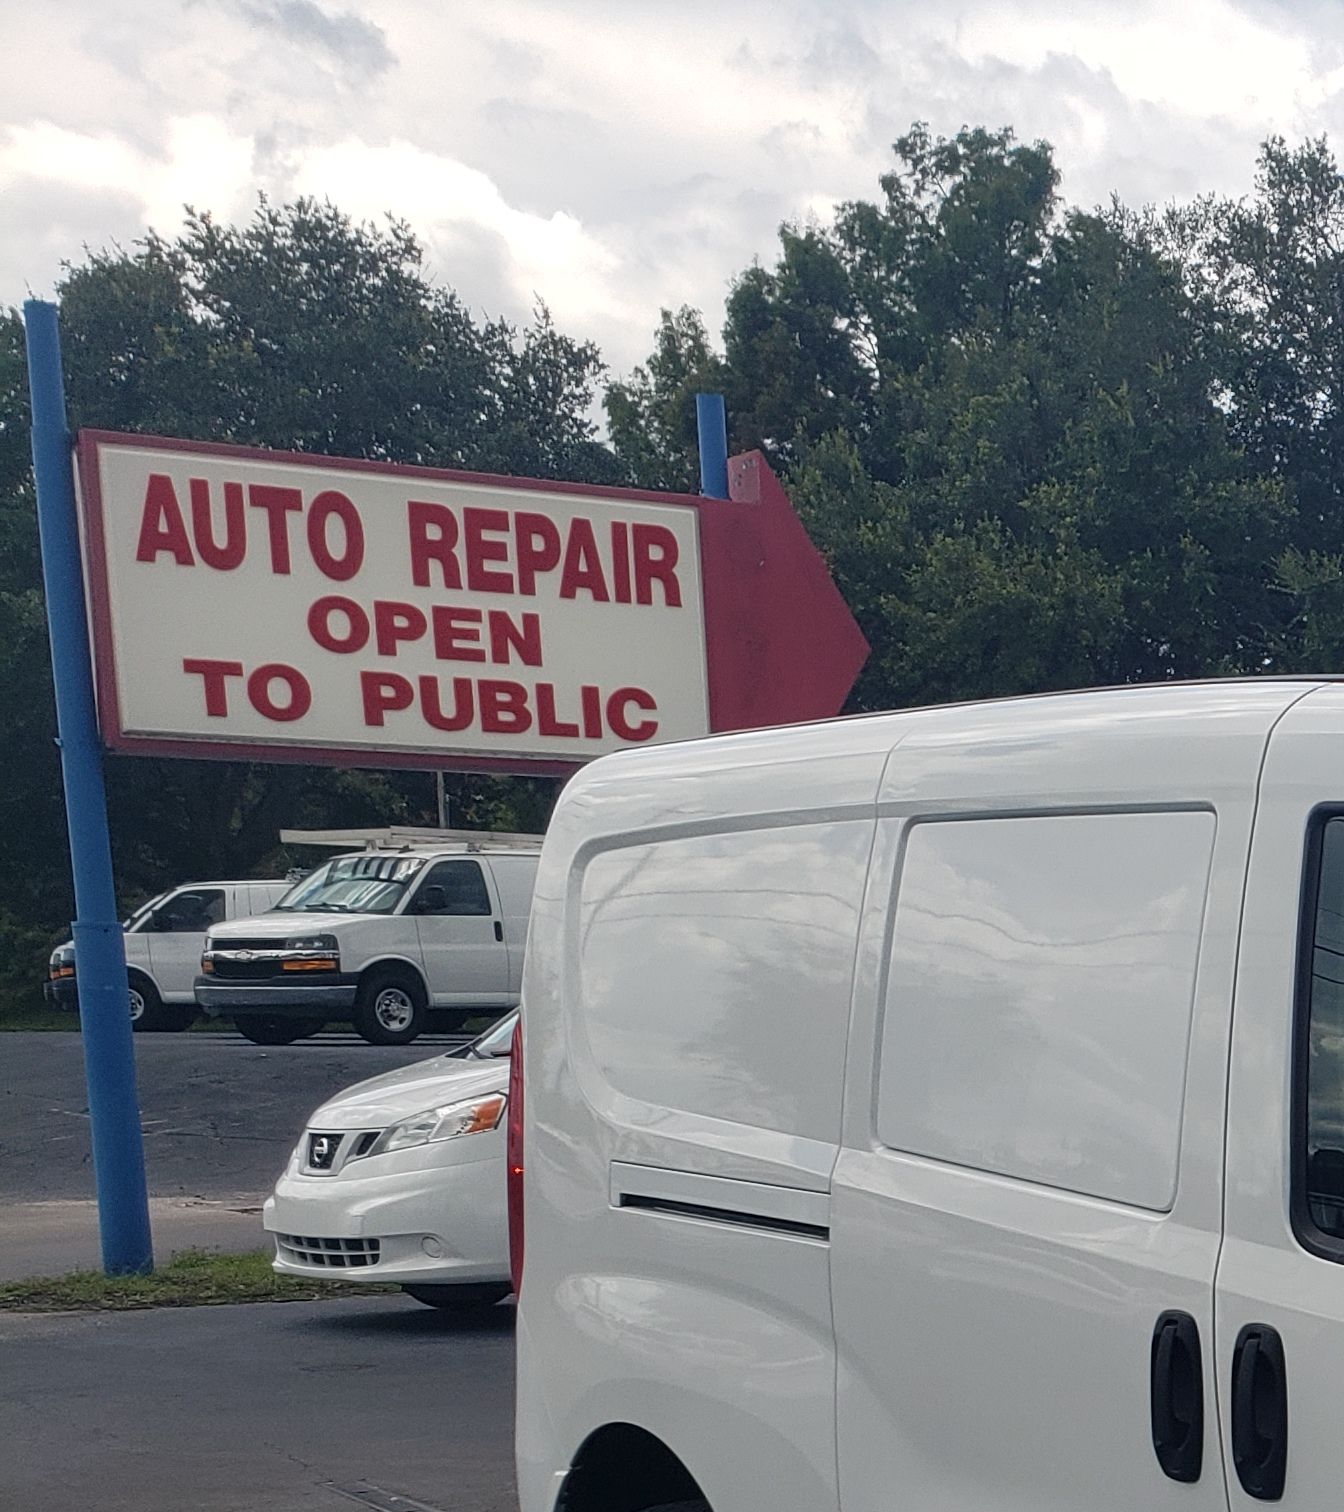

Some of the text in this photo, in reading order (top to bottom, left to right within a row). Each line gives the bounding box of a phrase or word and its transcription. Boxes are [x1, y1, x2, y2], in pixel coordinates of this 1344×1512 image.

[137, 474, 682, 607] AUTO REPAIR
[307, 595, 542, 666] OPEN
[183, 659, 658, 741] TO PUBLIC
